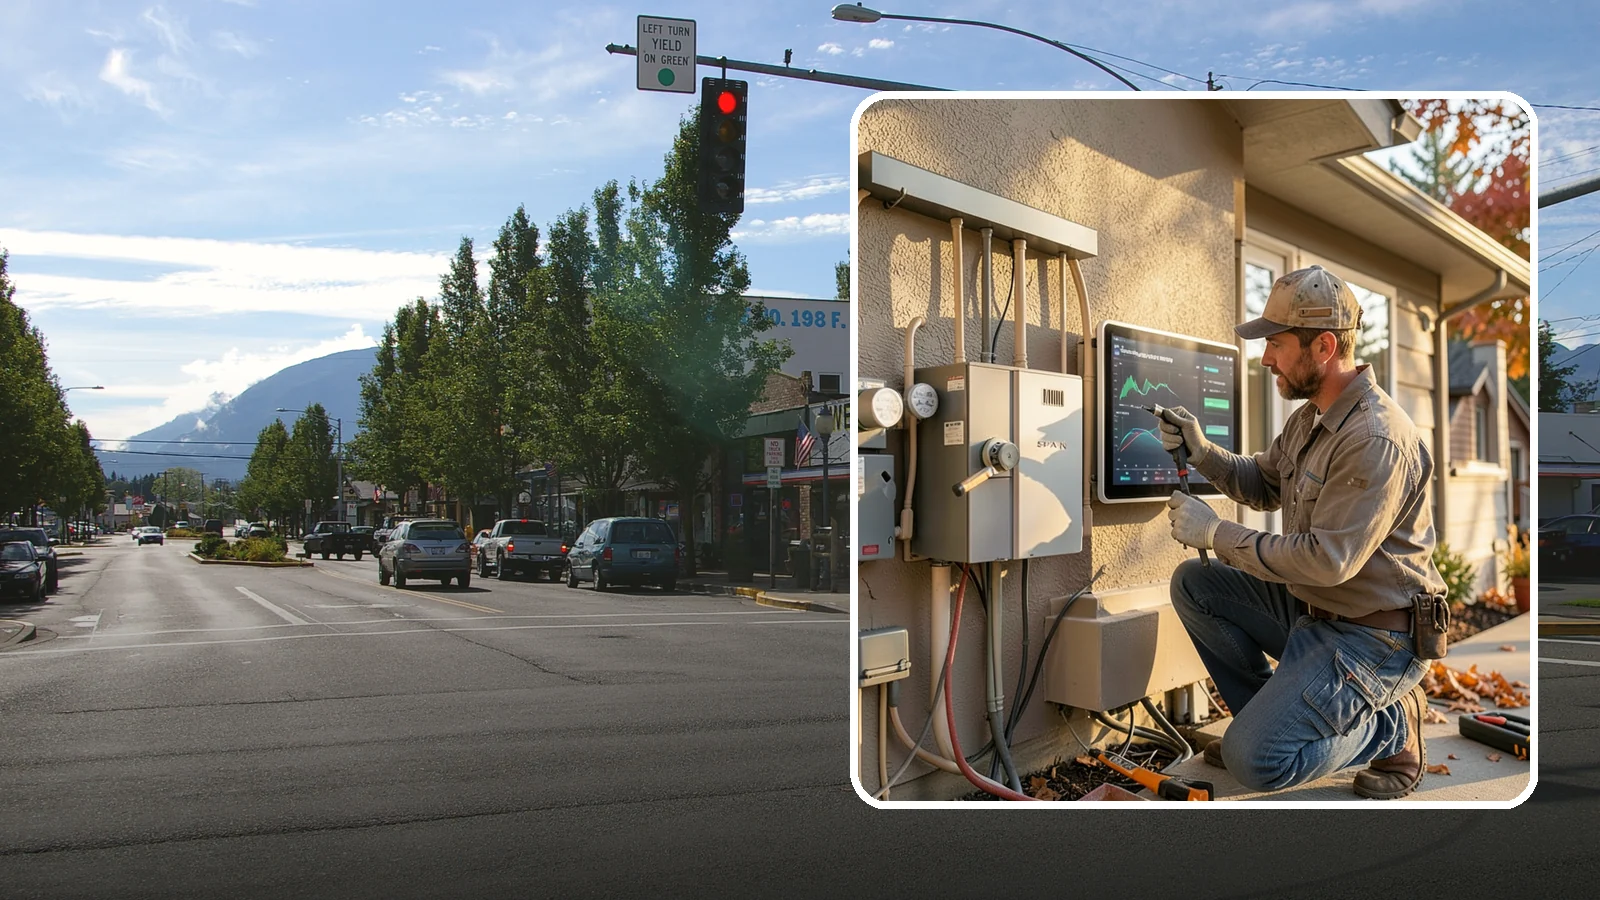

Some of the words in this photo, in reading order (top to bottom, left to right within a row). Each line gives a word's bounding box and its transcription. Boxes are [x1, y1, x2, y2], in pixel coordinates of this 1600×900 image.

[643, 24, 663, 34] LEFT
[668, 26, 690, 36] TURN
[652, 38, 682, 51] YIELD
[791, 310, 826, 328] 198
[831, 312, 846, 328] F.
[1036, 440, 1068, 450] SPAN
